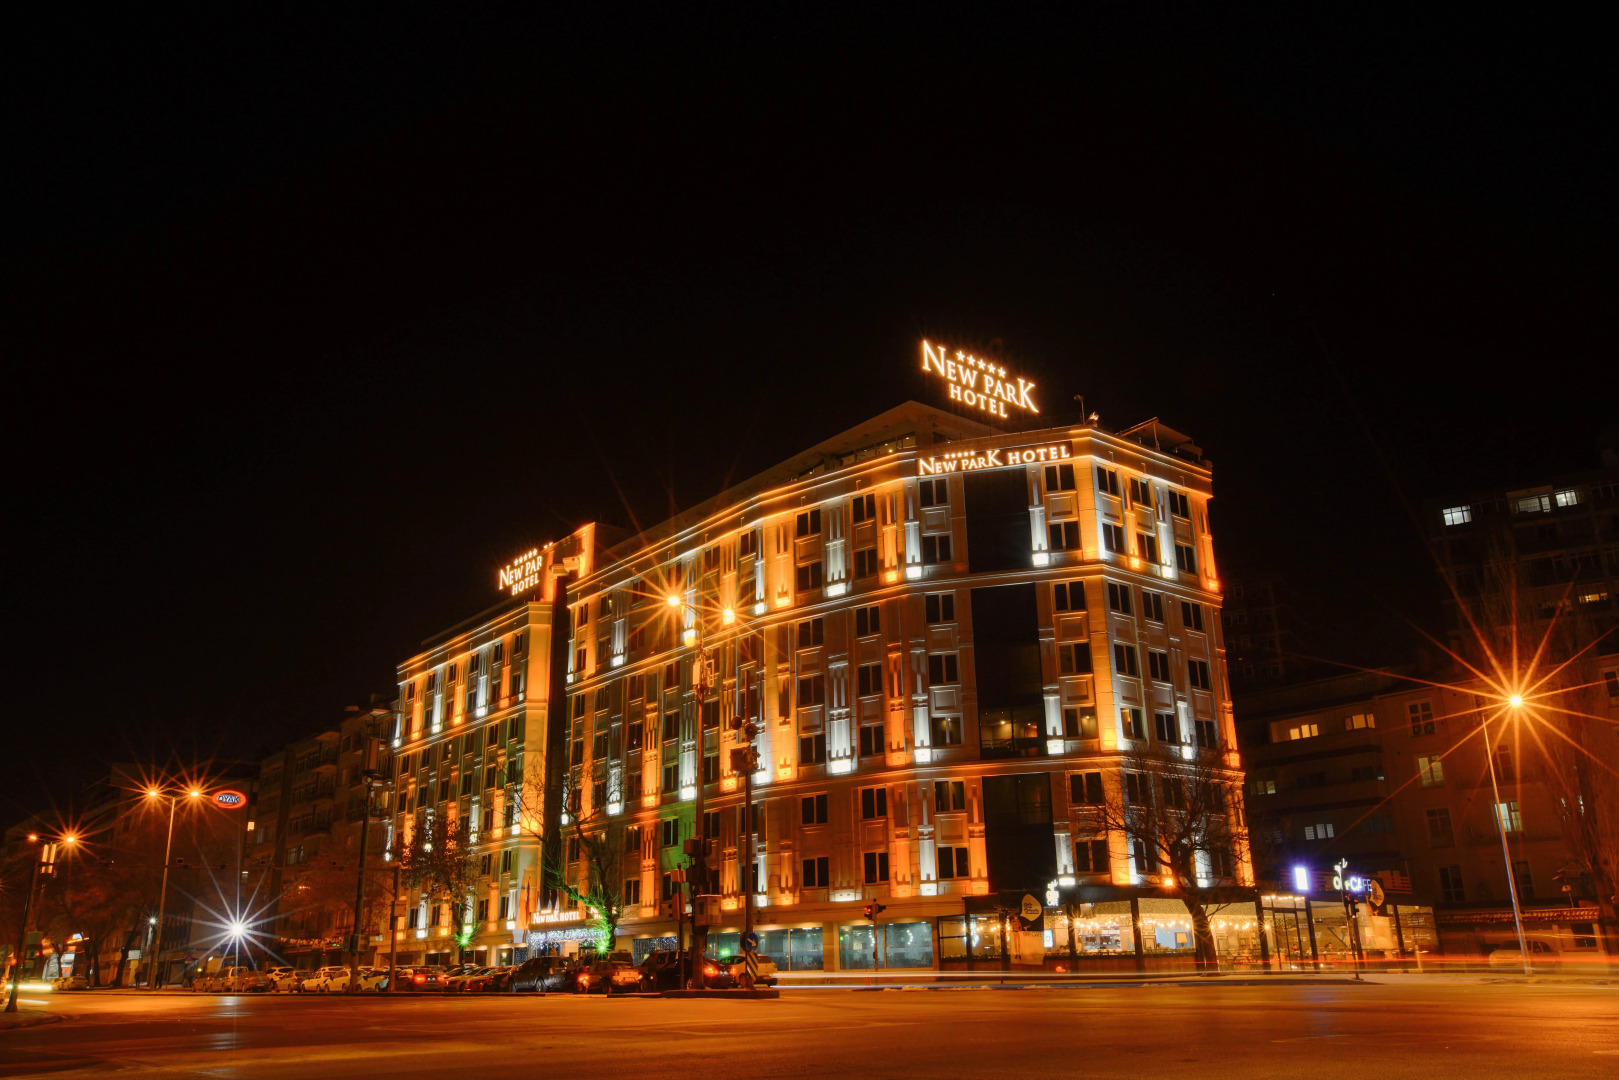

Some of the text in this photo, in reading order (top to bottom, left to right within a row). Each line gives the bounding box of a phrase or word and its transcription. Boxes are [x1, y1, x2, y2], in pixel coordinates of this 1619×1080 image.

[949, 382, 1008, 418] HOTEL
[1007, 445, 1070, 465] HOTEL
[511, 572, 540, 596] HOTEL
[559, 911, 580, 922] HOTEL
